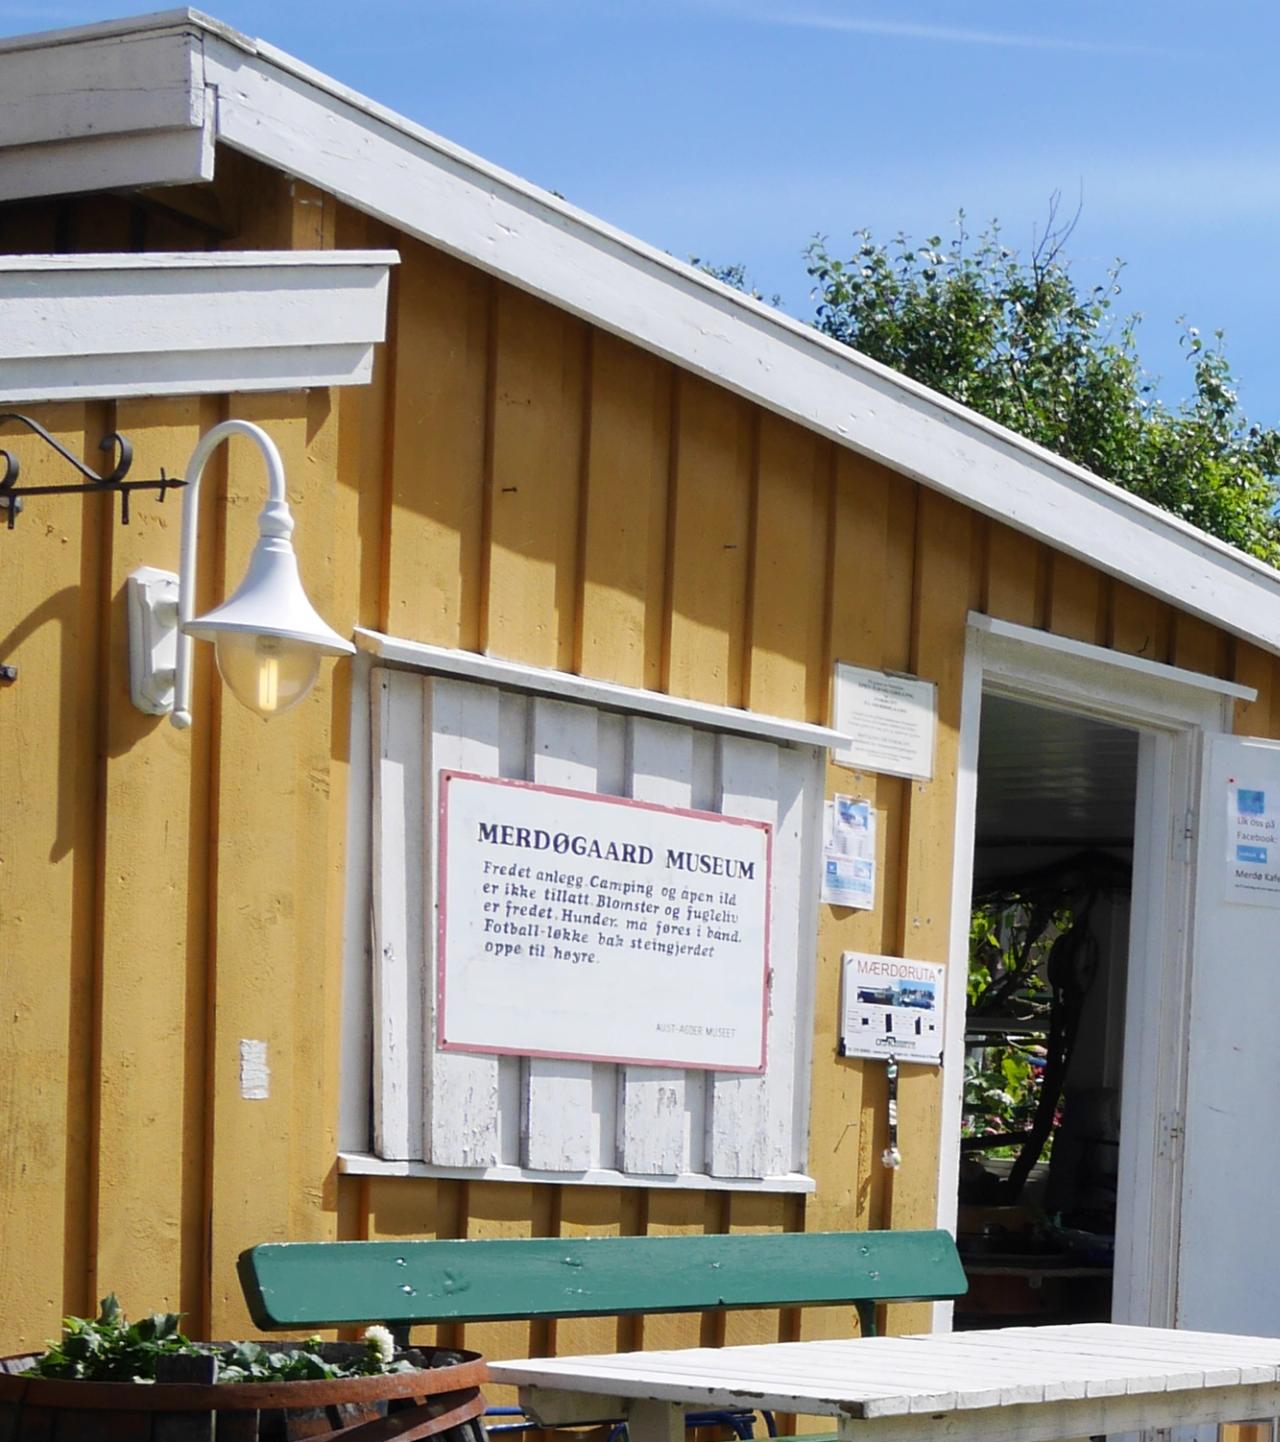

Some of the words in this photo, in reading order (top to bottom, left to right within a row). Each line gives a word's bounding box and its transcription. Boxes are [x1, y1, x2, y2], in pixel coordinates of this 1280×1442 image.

[478, 822, 654, 866] MERDØGAARD
[665, 849, 755, 880] MUSEUM
[483, 860, 531, 879] Fredet
[590, 875, 653, 899] Camping
[661, 886, 677, 901] og
[719, 892, 737, 906] ild
[483, 882, 499, 894] er
[504, 883, 537, 899] ikke
[596, 894, 660, 914] Blomster
[664, 905, 680, 920] og
[483, 901, 500, 913] er
[485, 941, 521, 957] oppe
[528, 943, 545, 957] til
[598, 932, 624, 947] bak
[630, 936, 715, 958] steingjerdet
[857, 960, 936, 981] MÆRDØRUTA
